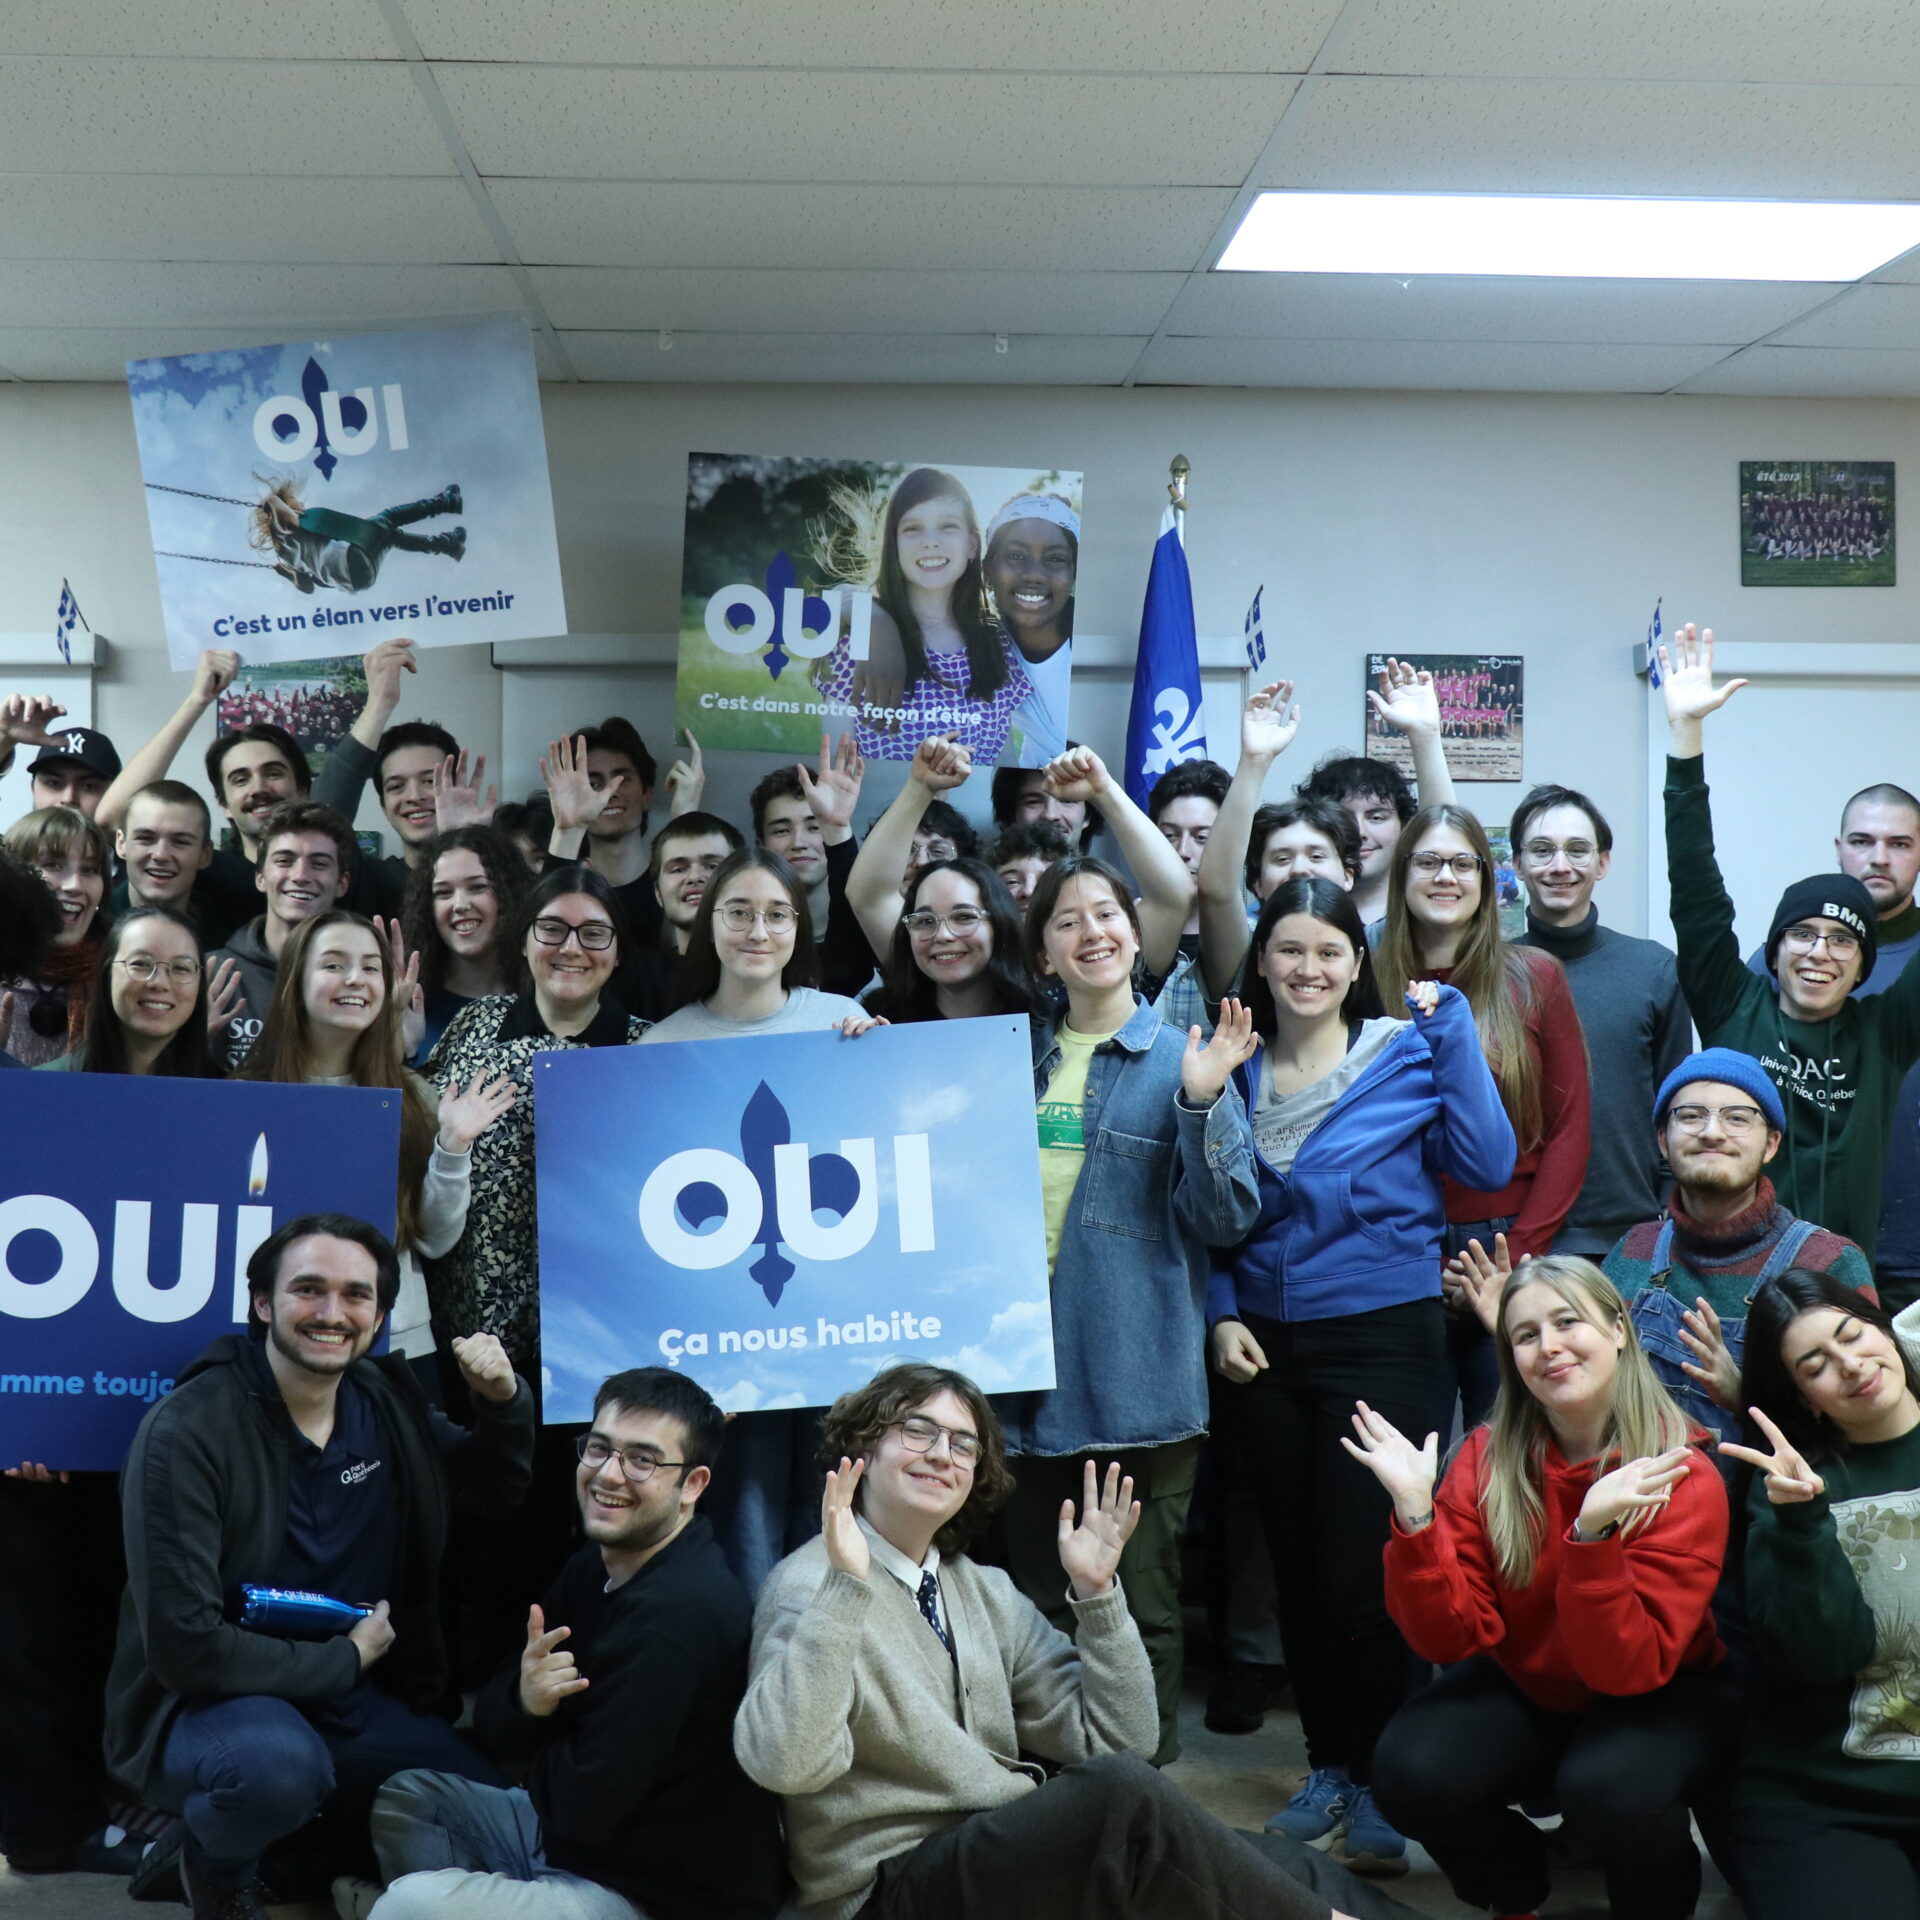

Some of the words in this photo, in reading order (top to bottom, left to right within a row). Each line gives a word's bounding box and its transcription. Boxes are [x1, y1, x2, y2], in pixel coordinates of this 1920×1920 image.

[253, 384, 409, 463] OUI
[213, 614, 272, 637] C'est
[277, 615, 306, 631] un
[312, 607, 364, 627] élan
[369, 604, 420, 622] vers
[426, 590, 515, 616] l'avenir
[704, 584, 873, 660] OUI
[700, 693, 748, 711] C'est
[753, 698, 800, 714] dans
[804, 699, 858, 717] notre
[863, 702, 919, 725] façon
[924, 705, 982, 725] d'être
[639, 1133, 936, 1270] OUI
[658, 1328, 708, 1367] Ça
[718, 1325, 808, 1354] nous
[816, 1310, 942, 1347] habite
